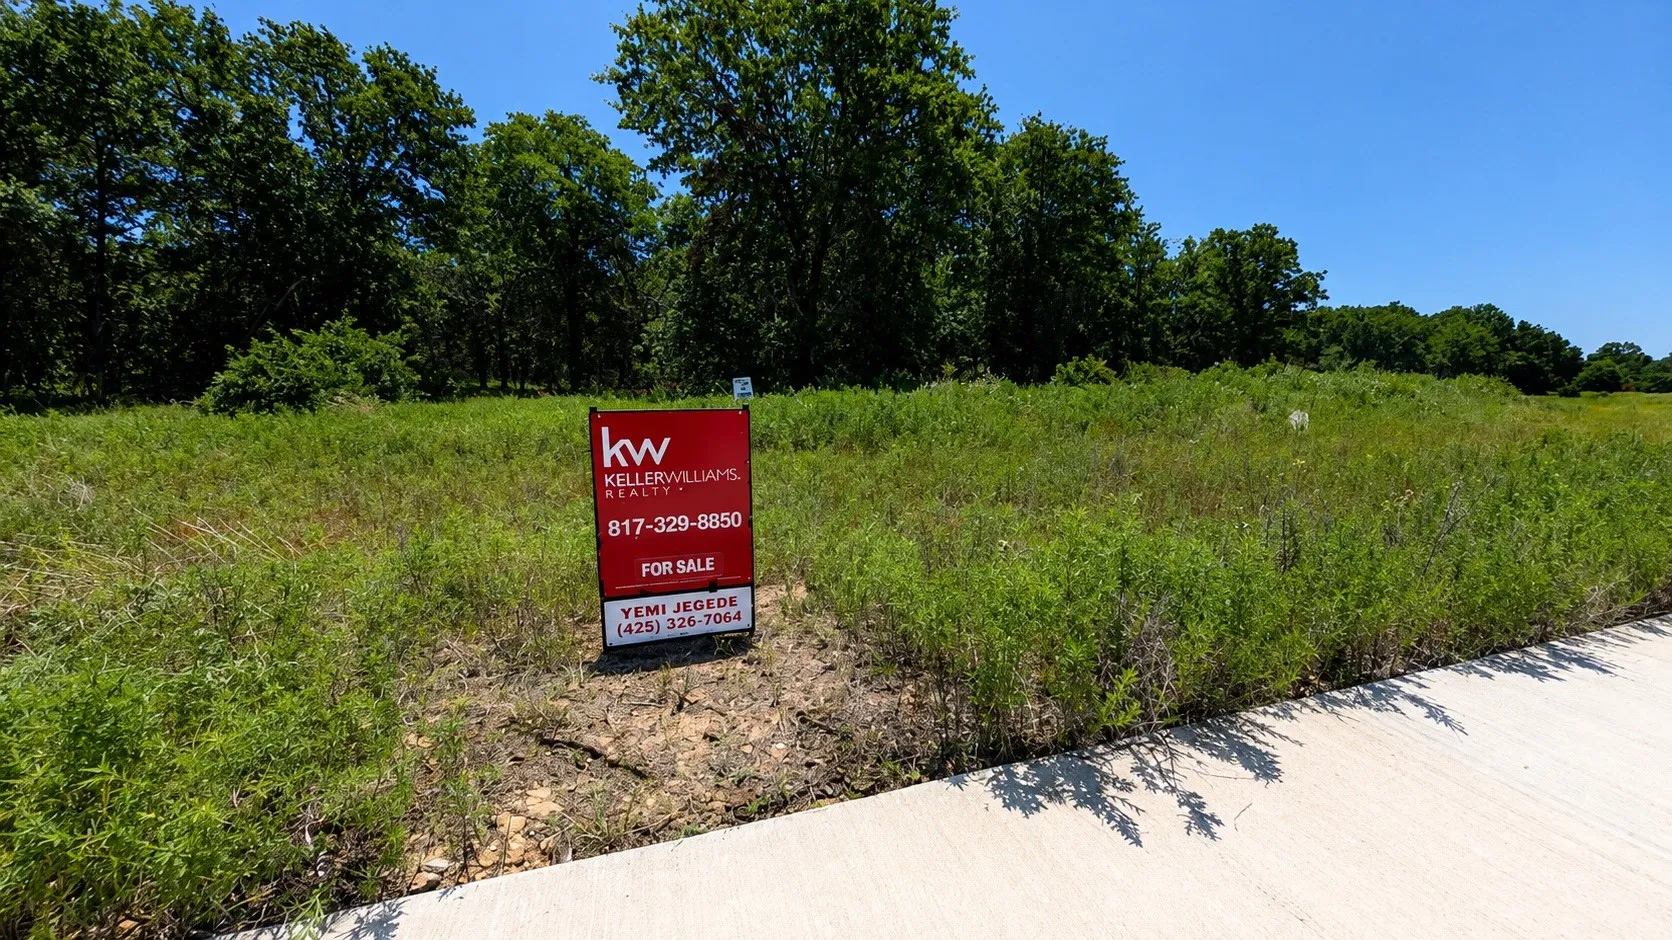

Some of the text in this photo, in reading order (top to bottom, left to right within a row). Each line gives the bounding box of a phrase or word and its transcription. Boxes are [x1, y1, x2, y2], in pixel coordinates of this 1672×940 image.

[601, 426, 671, 468] kw
[605, 486, 671, 499] REALTY
[607, 511, 742, 537] 817-329-8850
[641, 557, 715, 577] FOR SALE
[620, 596, 738, 619] YEMI JEGEDE
[617, 611, 742, 638] (425) 326-7064
